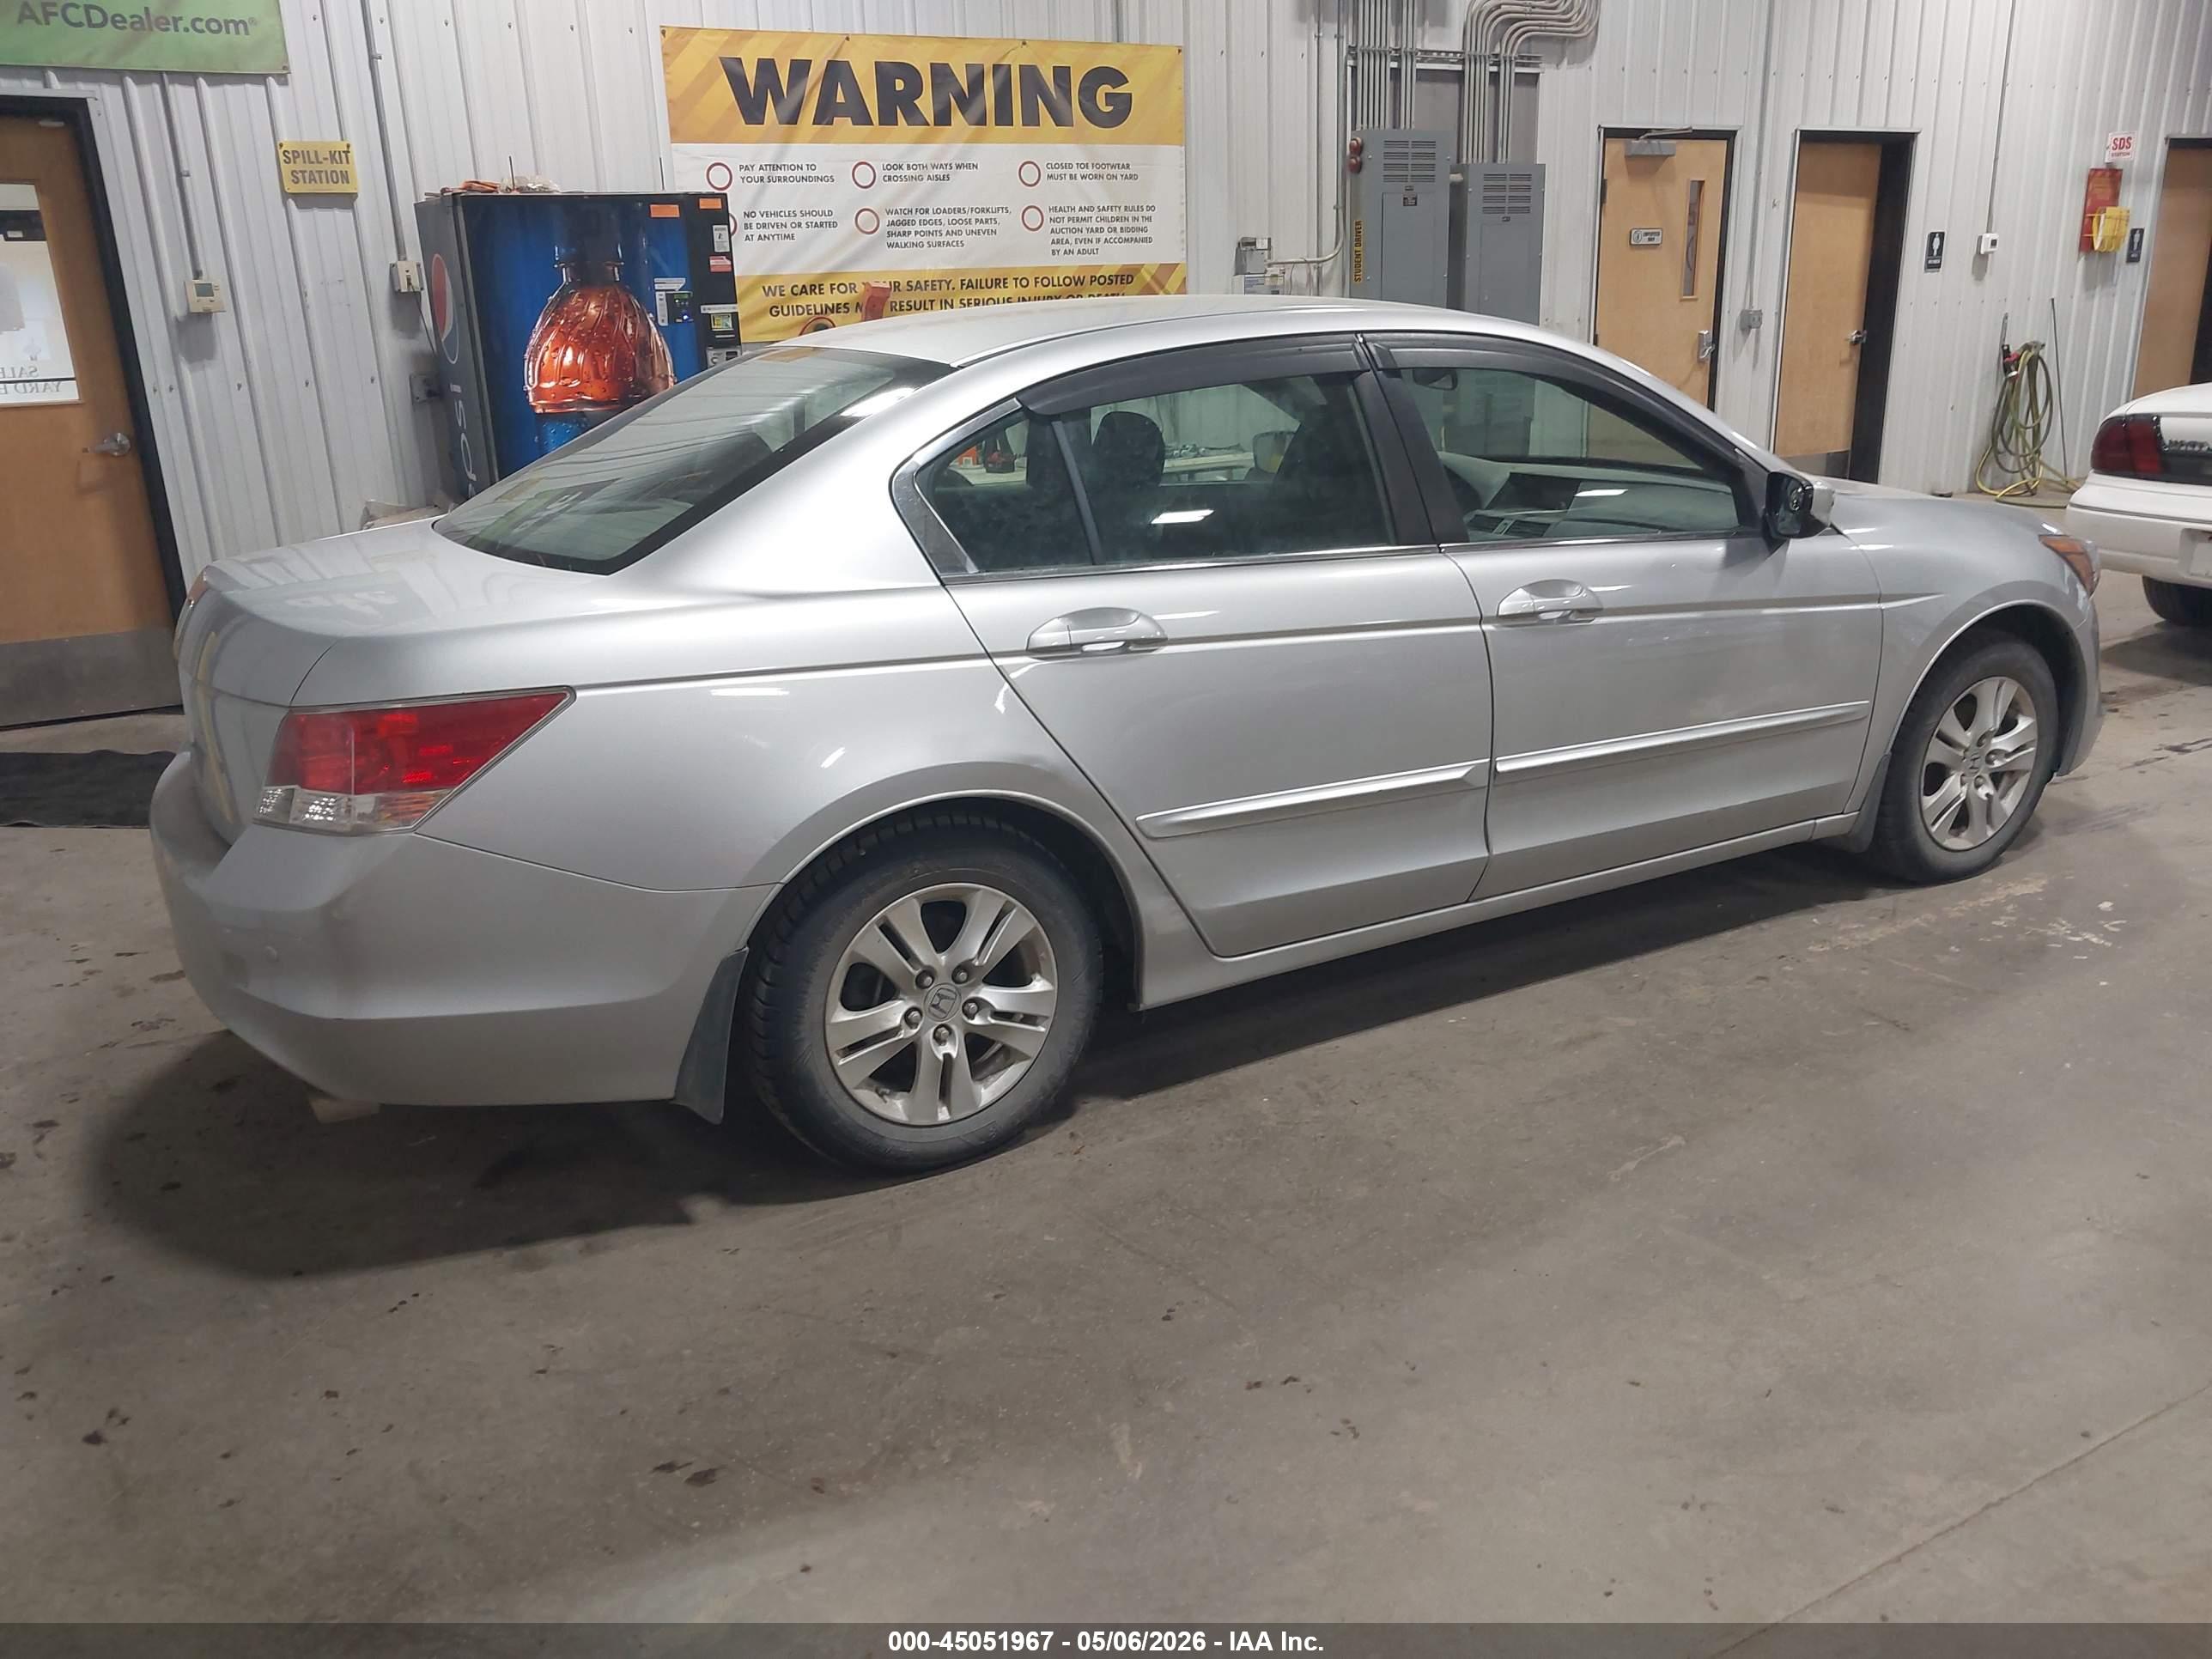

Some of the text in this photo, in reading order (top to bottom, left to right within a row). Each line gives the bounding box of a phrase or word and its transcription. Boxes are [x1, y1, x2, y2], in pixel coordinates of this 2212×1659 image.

[719, 57, 1133, 129] WARNING
[2112, 137, 2132, 151] SDS
[283, 149, 350, 165] SPILL-KIT
[758, 163, 803, 172] ATTENTION
[290, 169, 350, 185] STATION
[932, 206, 1012, 215] LOADERS/FORKLIFTS,
[756, 222, 787, 230] DRIVEN
[886, 219, 916, 228] JAGGED
[919, 218, 945, 227] EDGES,
[975, 217, 1000, 226] PARTS,
[1353, 220, 1363, 283] STUDENT DRIVER
[763, 284, 786, 297] WE
[790, 283, 825, 296] CARE
[830, 282, 858, 295] FOR
[906, 279, 955, 292] SAFETY.
[960, 277, 1008, 290] FAILURE
[1012, 276, 1030, 289] TO
[1034, 275, 1085, 288] FOLLOW
[1090, 274, 1134, 286] POSTED
[769, 302, 850, 317] GUIDELINES
[890, 299, 934, 312] RESULT
[939, 298, 954, 310] IN
